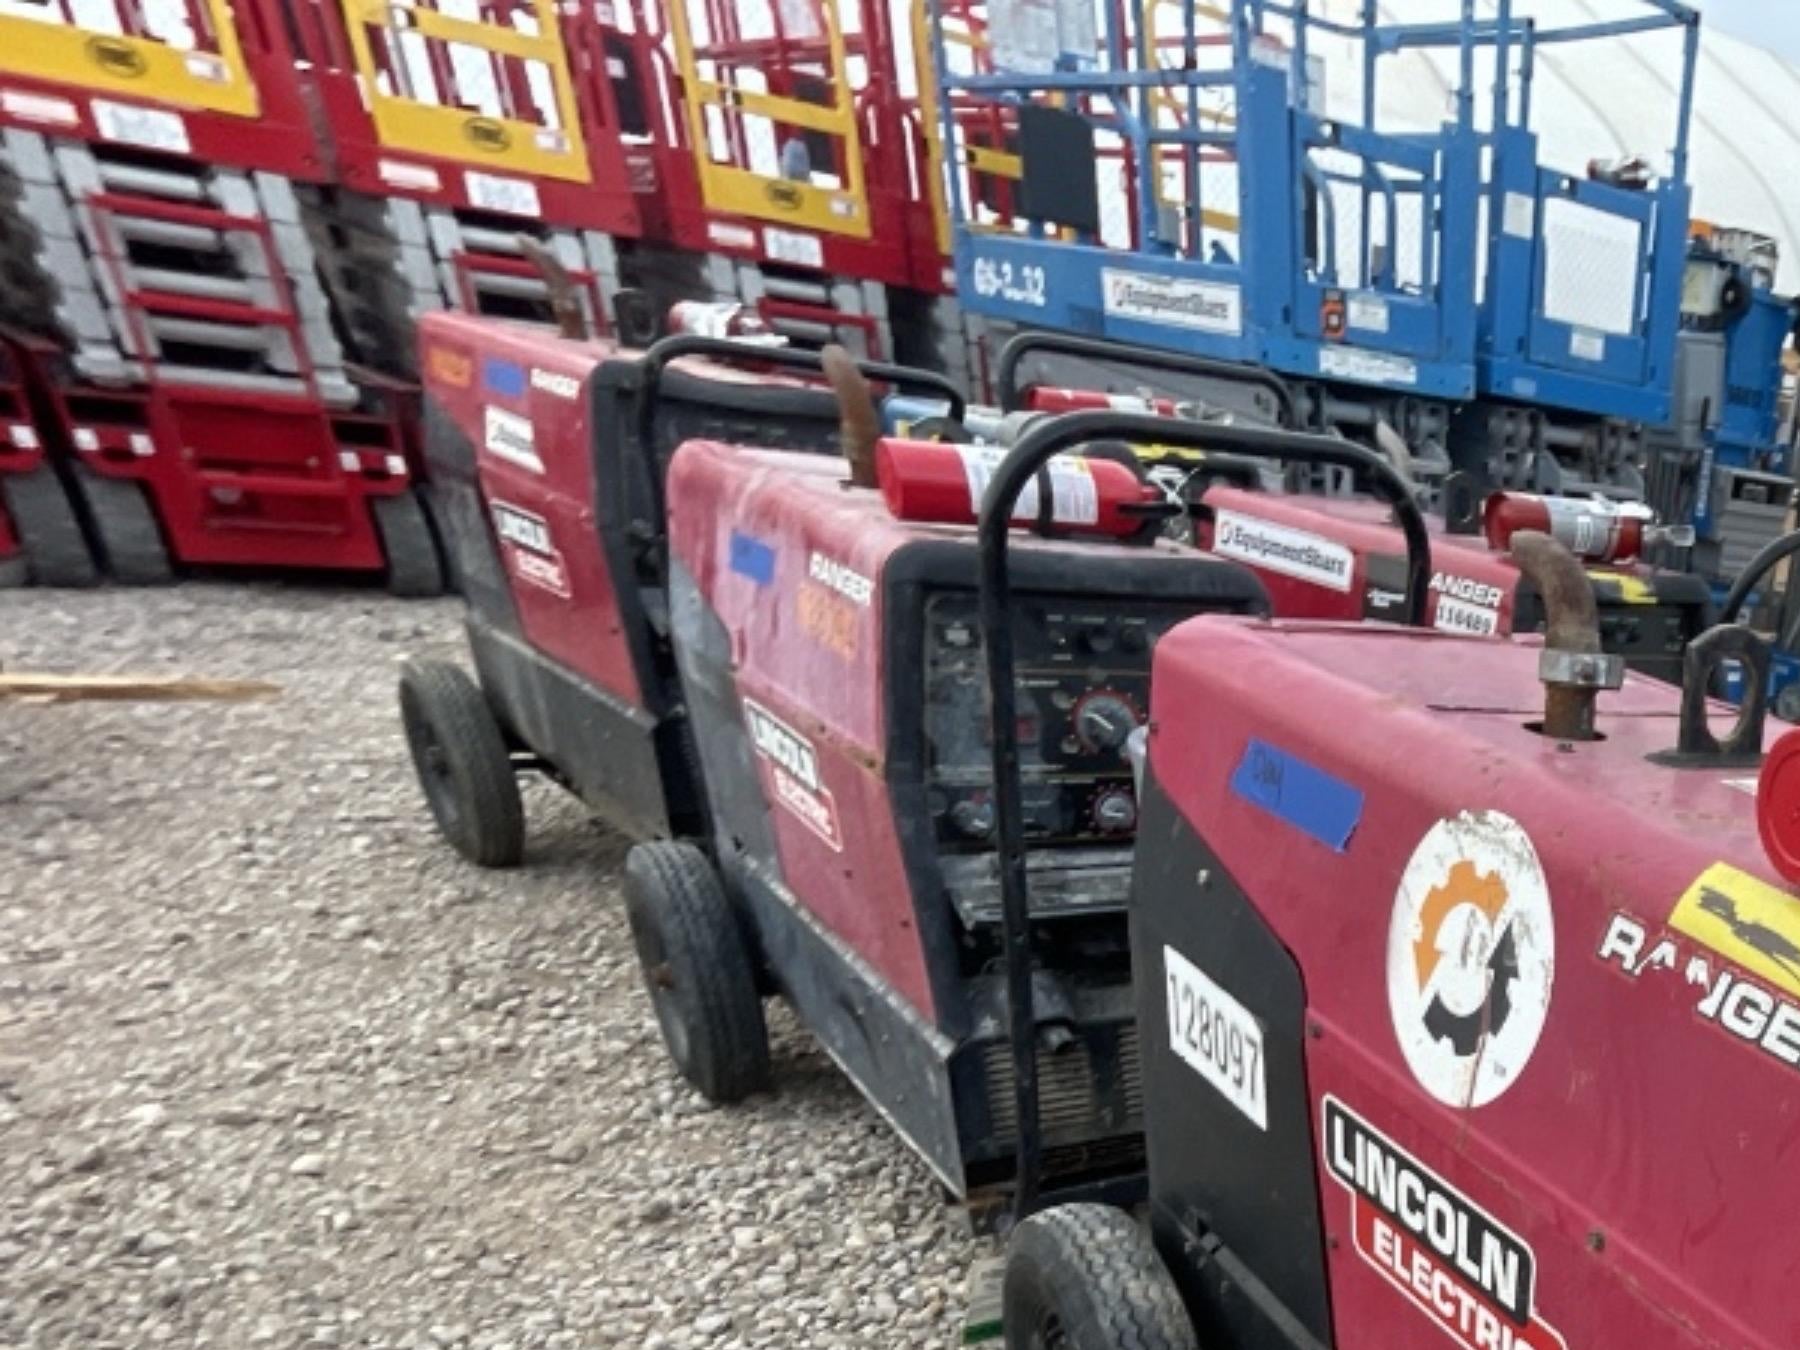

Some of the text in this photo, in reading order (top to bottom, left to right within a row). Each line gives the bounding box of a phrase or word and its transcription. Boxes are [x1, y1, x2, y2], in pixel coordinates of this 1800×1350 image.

[809, 550, 876, 607] RANGER
[1234, 525, 1346, 578] EquipmentShare
[1428, 571, 1505, 608] ANGER
[749, 710, 818, 790] LINCOLN
[1169, 973, 1259, 1102] 128097
[1333, 1115, 1520, 1310] LINCOLN
